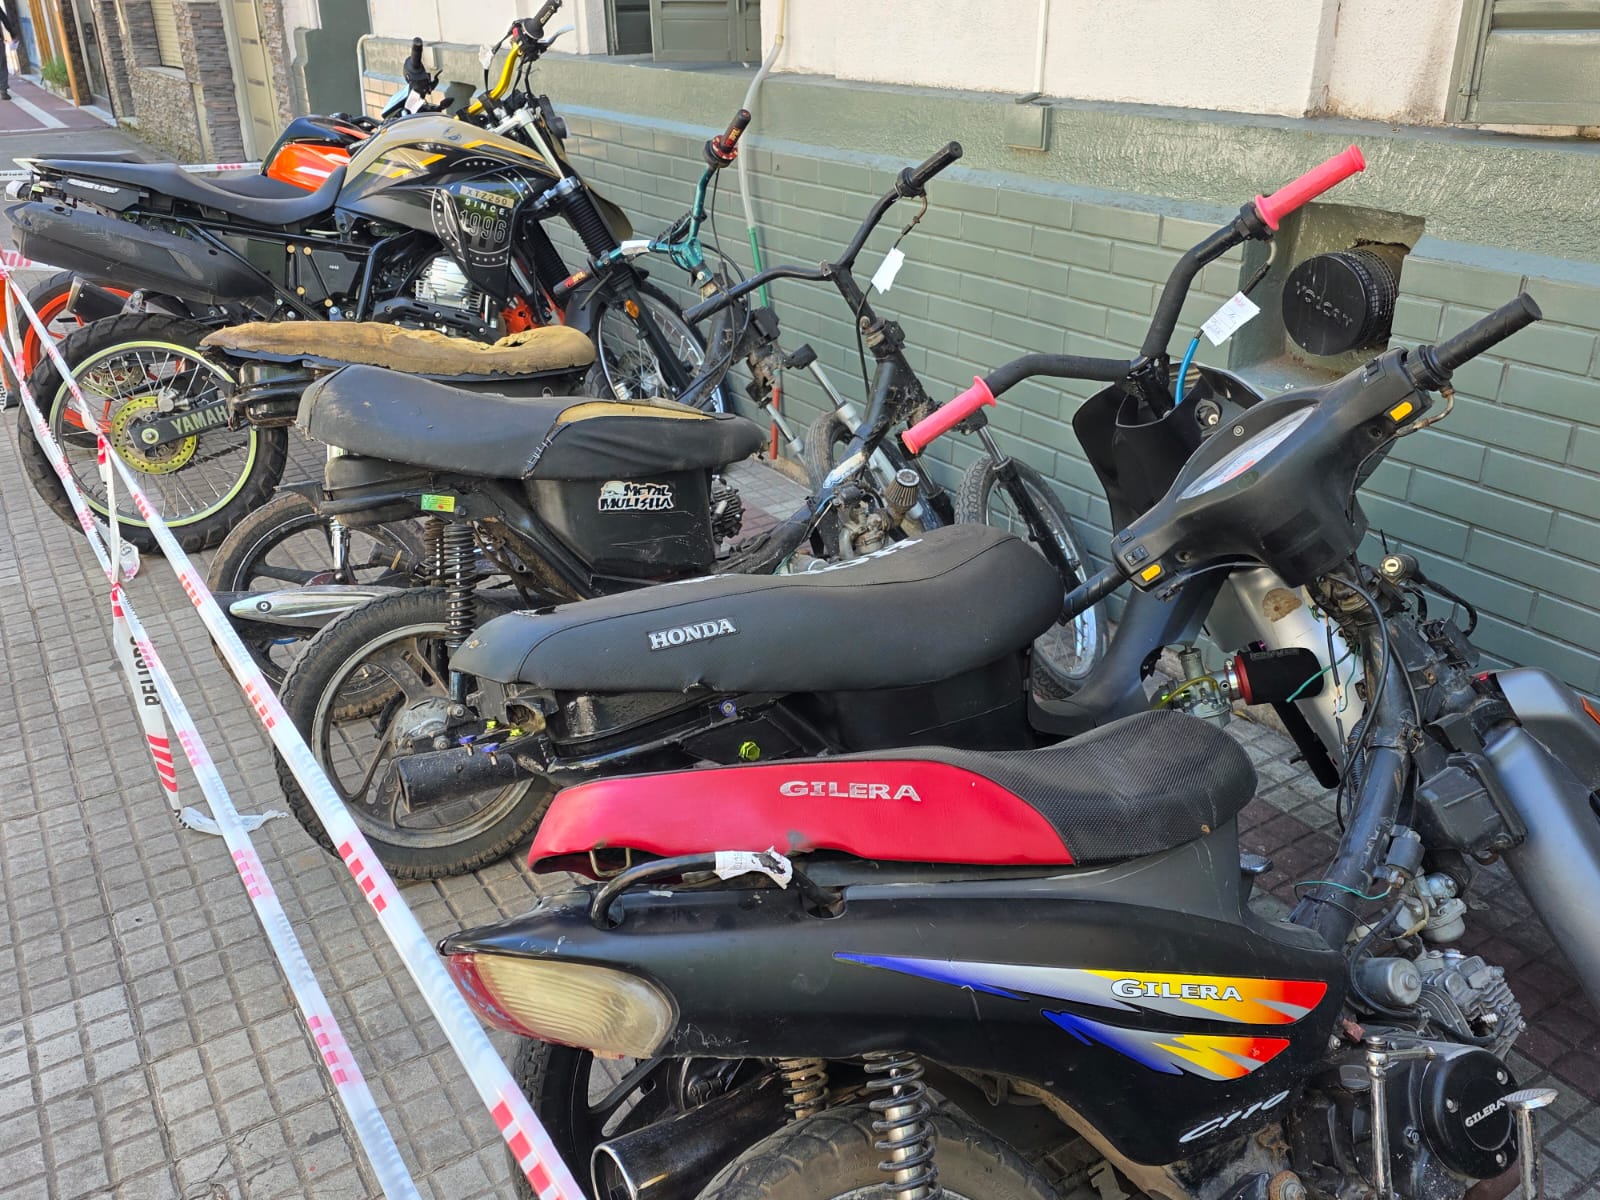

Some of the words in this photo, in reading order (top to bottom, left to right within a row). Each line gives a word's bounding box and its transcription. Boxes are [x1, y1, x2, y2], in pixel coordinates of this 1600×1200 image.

[465, 198, 505, 216] SINCE
[467, 189, 508, 205] XTZ250
[460, 209, 507, 243] 1996
[170, 405, 229, 435] YAMAH
[624, 482, 672, 497] METAL
[648, 618, 737, 650] HONDA
[779, 780, 922, 802] GILERA
[1110, 978, 1244, 1002] GILERA
[1465, 1099, 1506, 1127] GILERA
